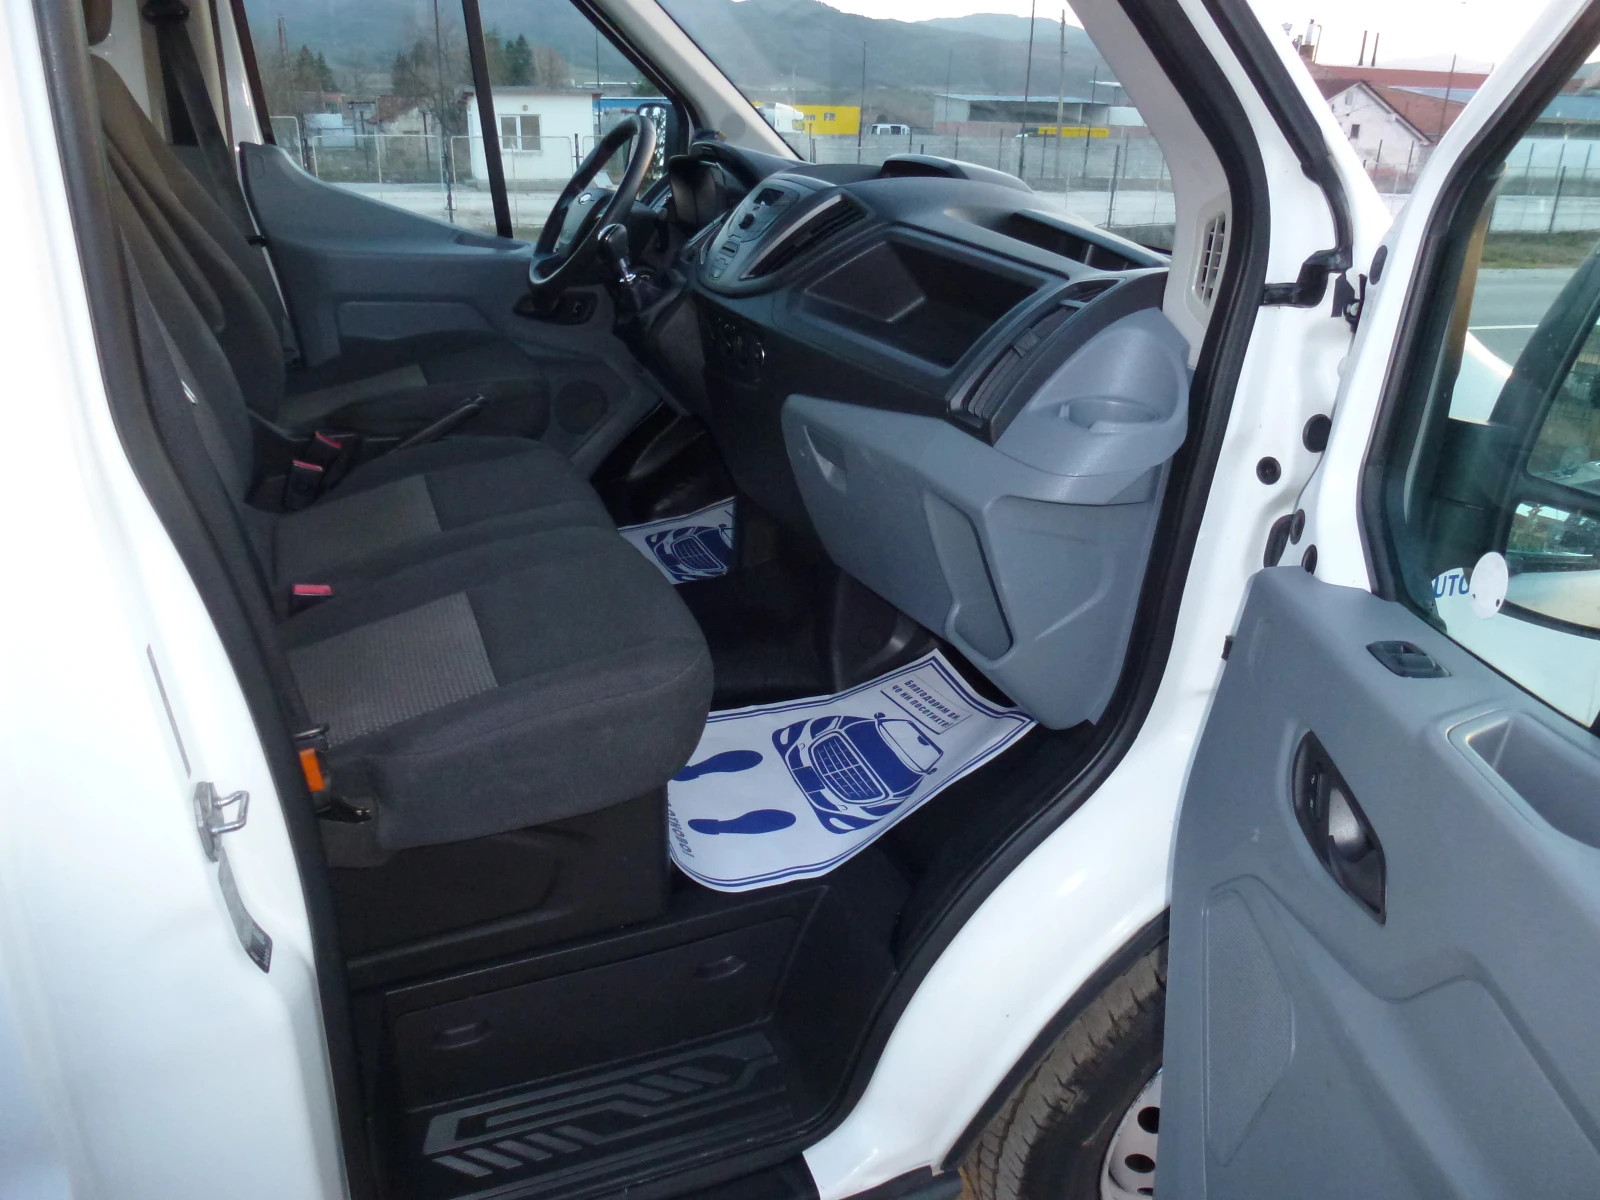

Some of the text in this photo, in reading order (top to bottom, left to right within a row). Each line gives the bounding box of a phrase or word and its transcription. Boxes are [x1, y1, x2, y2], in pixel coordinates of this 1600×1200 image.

[824, 112, 836, 121] FR
[892, 685, 953, 729] че ни посетихте!
[904, 680, 950, 714] Благодарим
